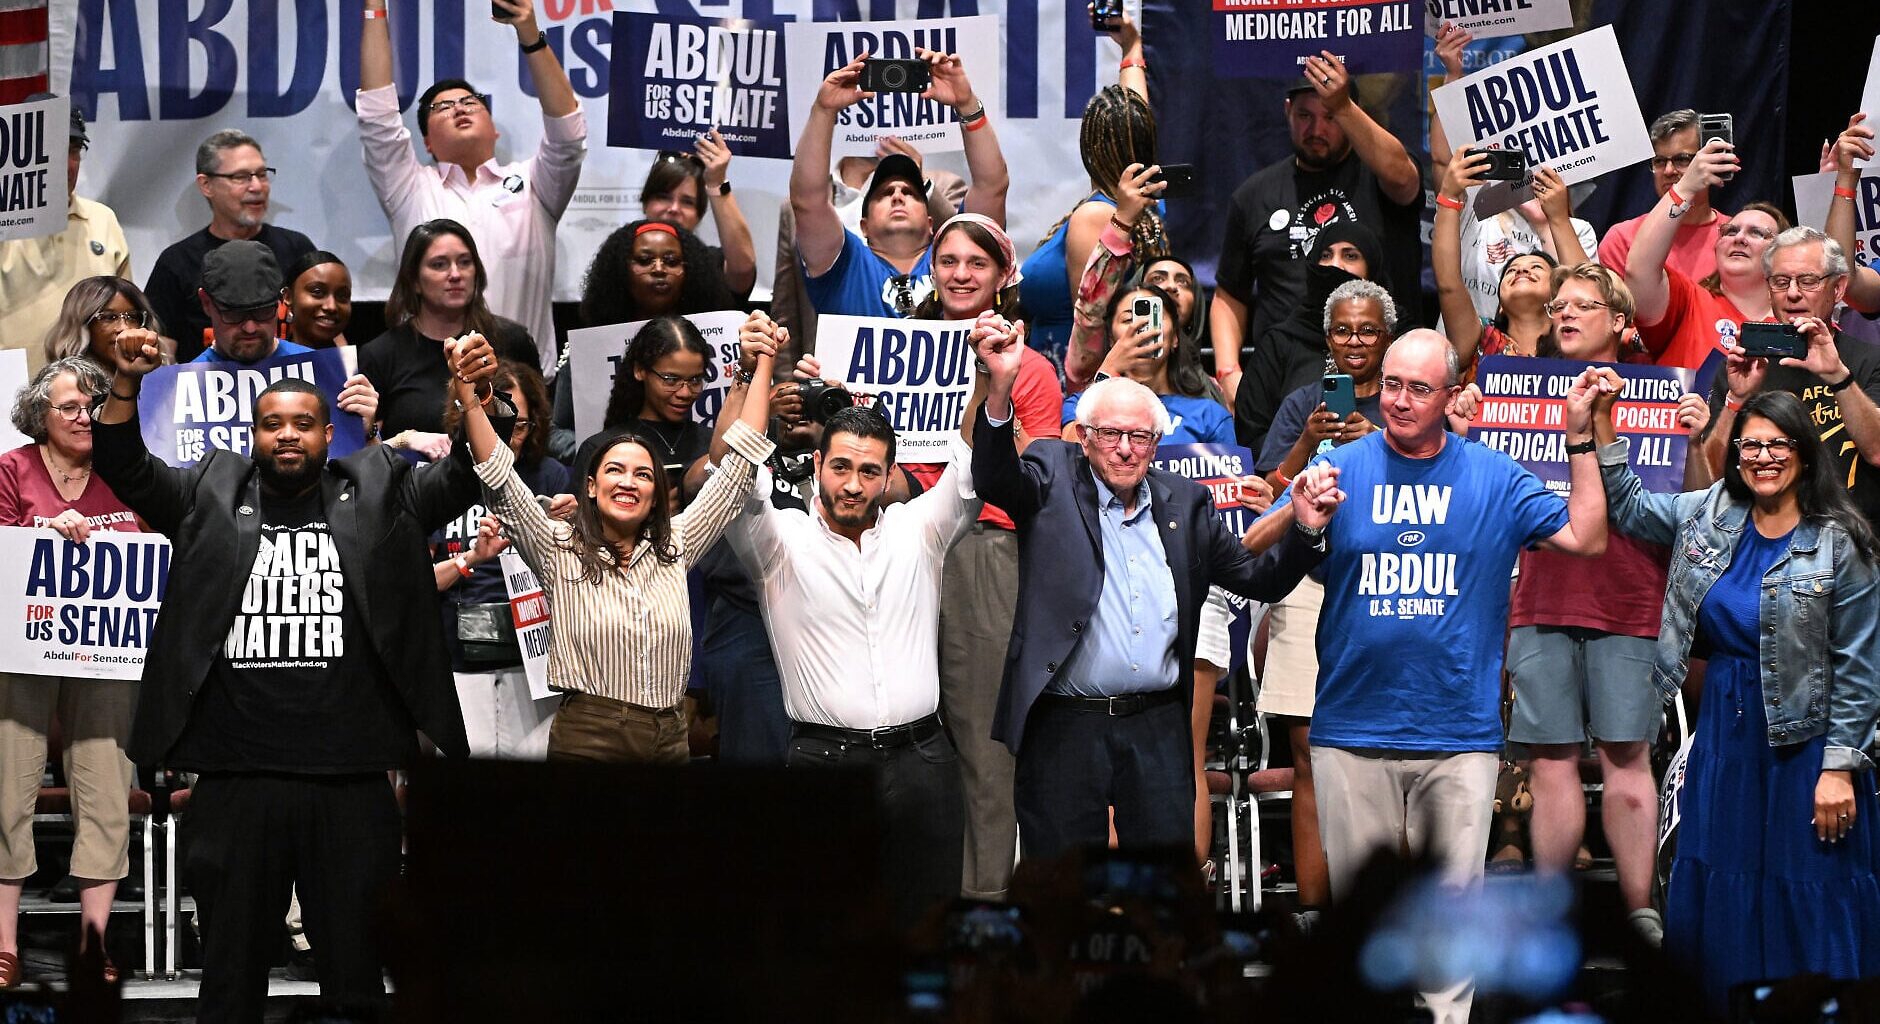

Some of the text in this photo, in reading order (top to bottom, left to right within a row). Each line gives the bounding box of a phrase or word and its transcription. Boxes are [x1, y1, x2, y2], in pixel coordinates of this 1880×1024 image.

[1225, 4, 1412, 40] MEDICARE FOR ALL
[644, 22, 781, 87] ABDUL
[645, 84, 672, 100] FOR
[645, 99, 671, 120] US
[675, 84, 778, 129] SENATE
[1465, 48, 1597, 142] ABDUL
[1504, 105, 1610, 168] SENATE
[846, 327, 970, 388] ABDUL
[1485, 373, 1542, 396] MONEY
[878, 390, 966, 431] SENATE
[1482, 402, 1679, 430] MONEY IN POCKET
[176, 429, 205, 446] FOR
[177, 443, 206, 462] US
[1480, 431, 1569, 462] MEDICAR
[1637, 438, 1673, 466] ALL
[1372, 484, 1452, 524] UAW
[1403, 534, 1419, 542] FOR
[1358, 552, 1459, 595] ABDUL
[241, 571, 343, 614] OTERS
[1369, 598, 1444, 616] U.S. SENATE
[26, 604, 54, 621] FOR
[58, 604, 158, 648] SENAT
[26, 620, 54, 641] US
[43, 651, 144, 664] AbdulForSenate.co
